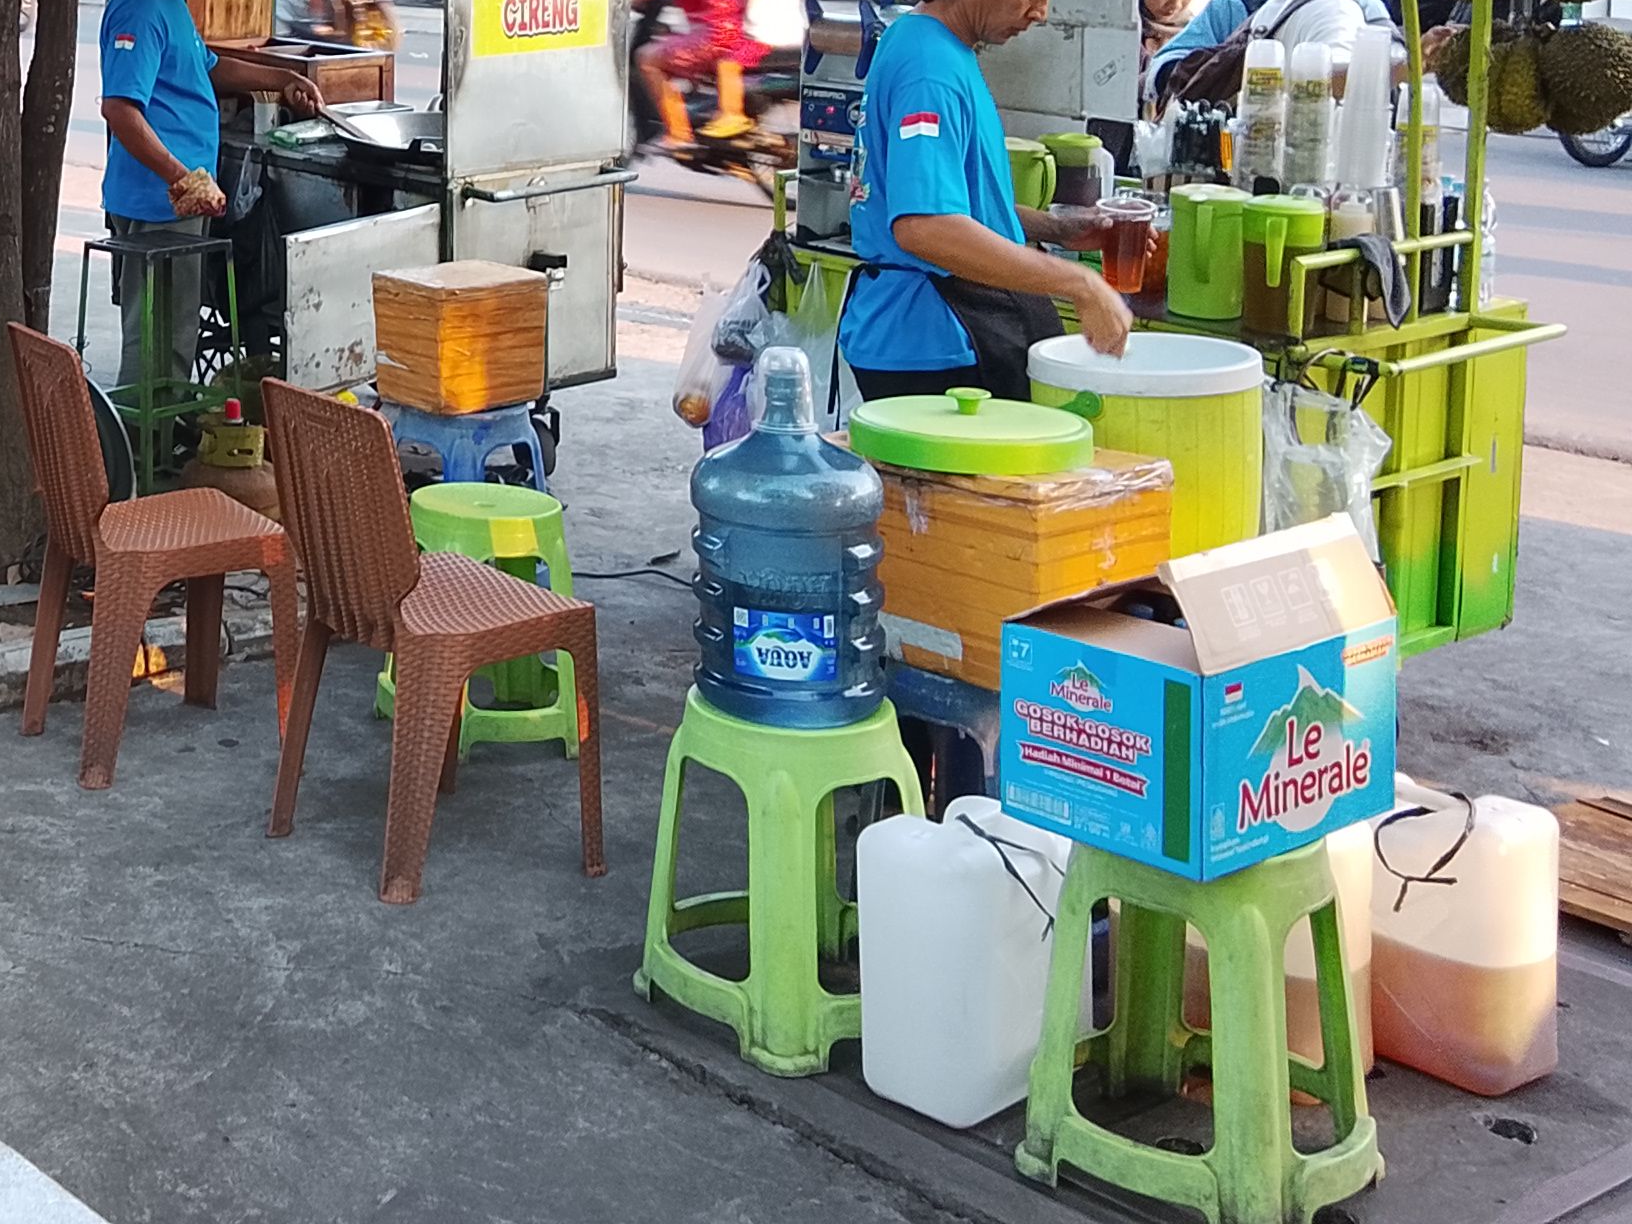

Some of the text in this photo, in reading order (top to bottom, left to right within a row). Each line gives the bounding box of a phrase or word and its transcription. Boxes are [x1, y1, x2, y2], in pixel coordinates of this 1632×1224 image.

[755, 644, 814, 670] AQUA
[1049, 679, 1113, 714] Minerale
[1070, 672, 1089, 693] Le
[1014, 699, 1152, 754] GOSOK-GOSOK
[1028, 717, 1137, 763] BERHADIAH
[1286, 718, 1323, 769] Le
[1024, 746, 1061, 765] Hadiah
[1061, 754, 1104, 780] Minimal
[1237, 743, 1370, 831] Minerale
